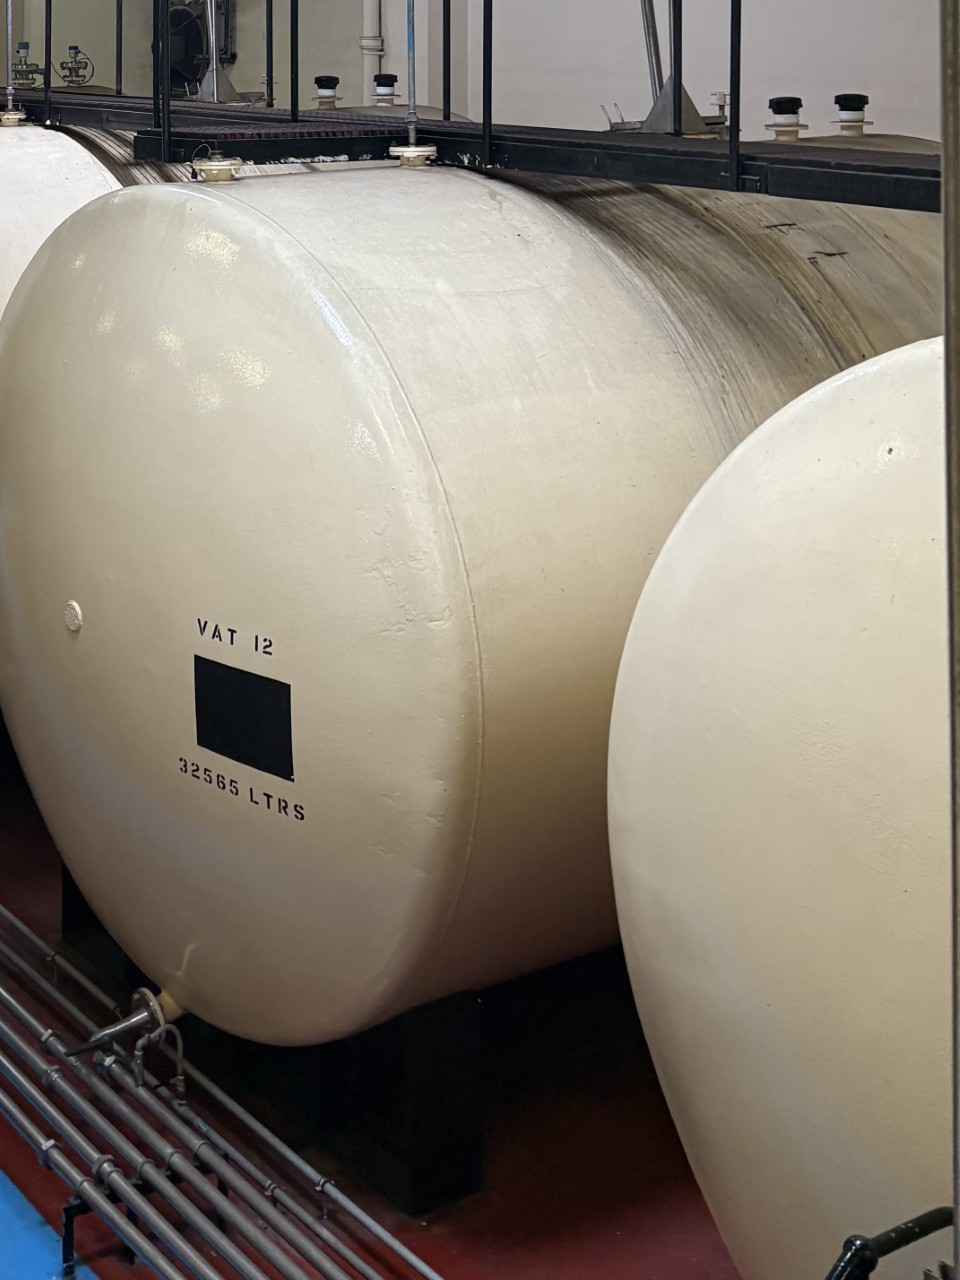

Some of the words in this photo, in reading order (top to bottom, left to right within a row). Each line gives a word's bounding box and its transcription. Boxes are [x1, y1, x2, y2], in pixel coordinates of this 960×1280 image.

[197, 618, 237, 646] VAT
[254, 634, 273, 656] 12
[179, 756, 239, 797] 32565
[249, 787, 305, 822] LTRS
